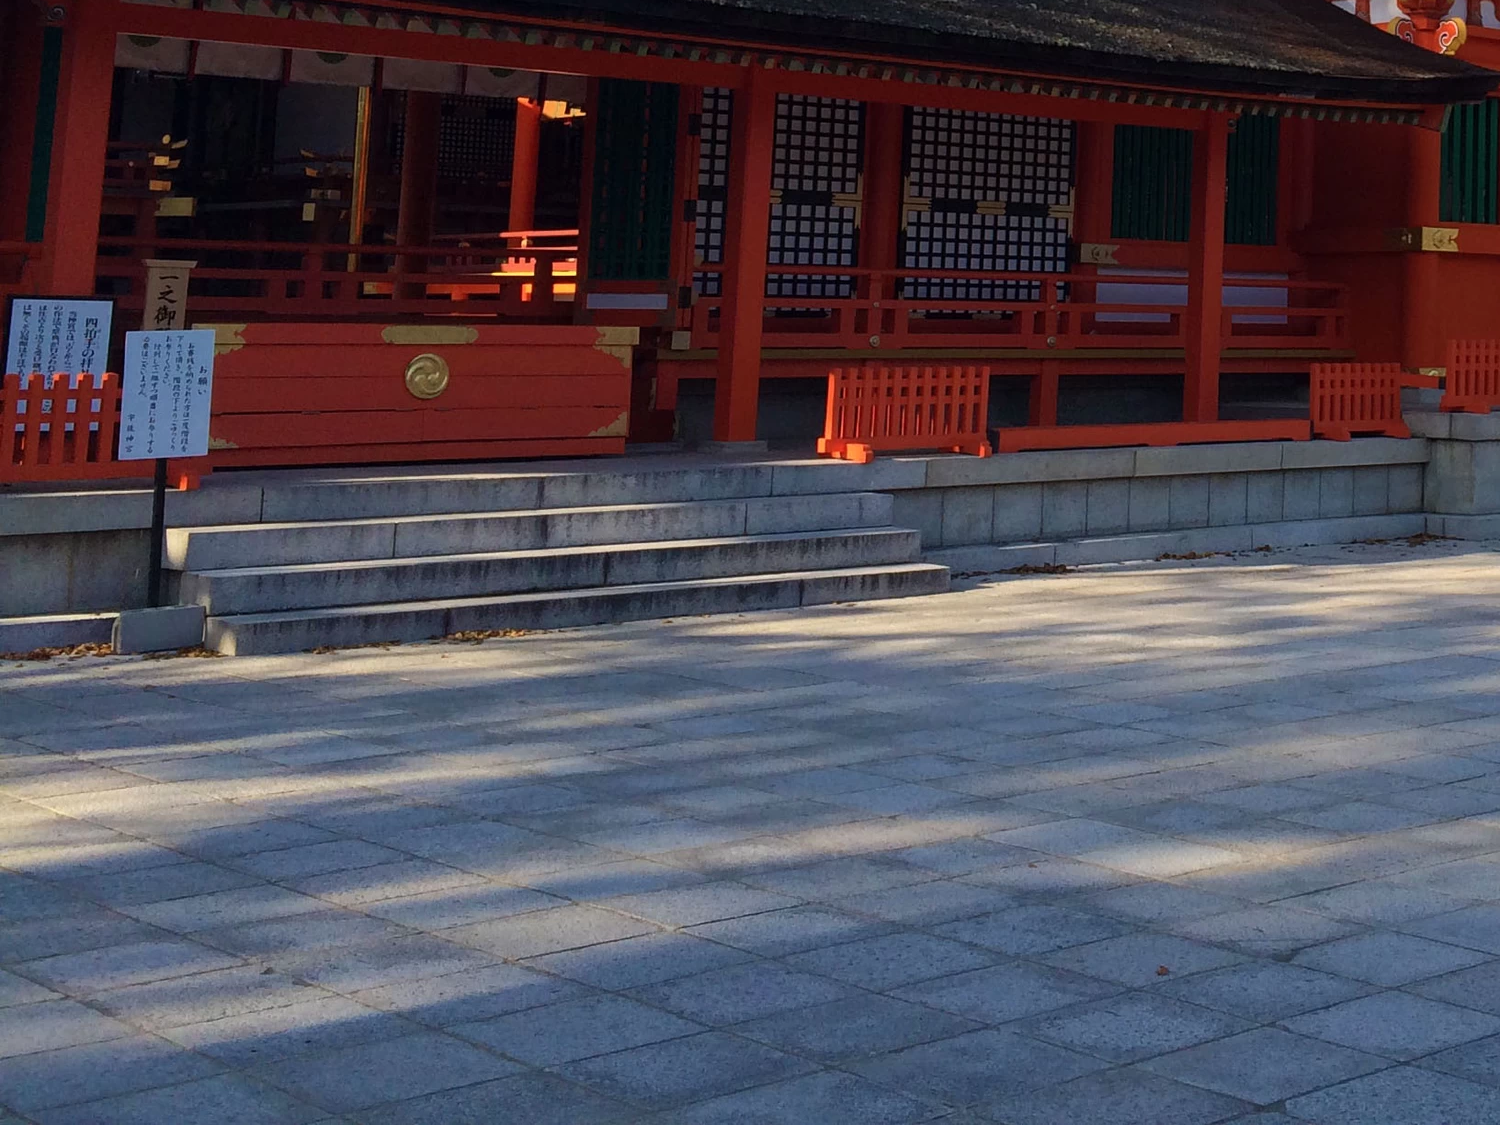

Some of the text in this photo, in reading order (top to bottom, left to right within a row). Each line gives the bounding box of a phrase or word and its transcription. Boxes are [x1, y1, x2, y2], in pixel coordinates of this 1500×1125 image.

[154, 275, 179, 331] 一之御
[197, 365, 208, 395] お願い
